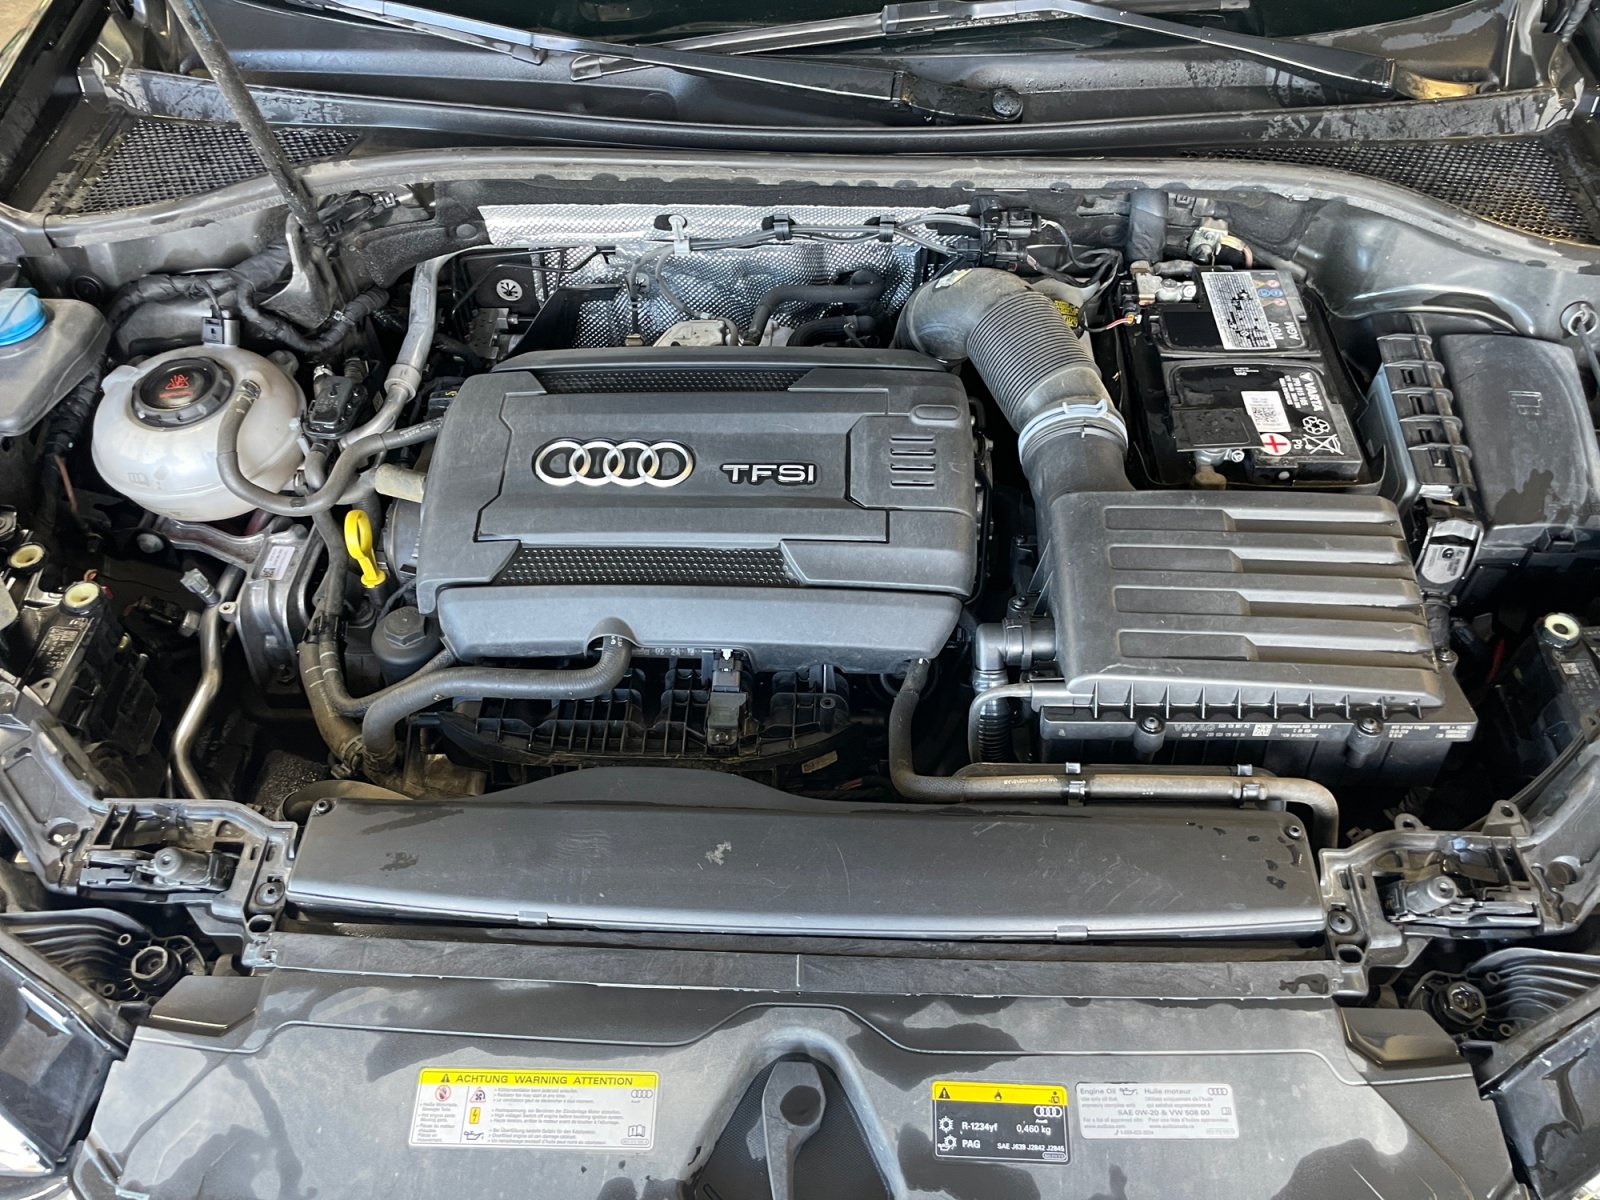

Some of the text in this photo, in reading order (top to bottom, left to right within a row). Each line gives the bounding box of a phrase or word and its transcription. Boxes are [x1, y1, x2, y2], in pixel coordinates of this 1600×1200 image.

[1304, 382, 1324, 412] VARTA
[1291, 439, 1303, 450] Pb
[722, 464, 814, 483] TFSI
[456, 1075, 633, 1085] ACHTUNG WARNING ATTENTION
[961, 1121, 998, 1133] R-1234yf
[1041, 1124, 1052, 1135] kg
[962, 1140, 980, 1148] PAG
